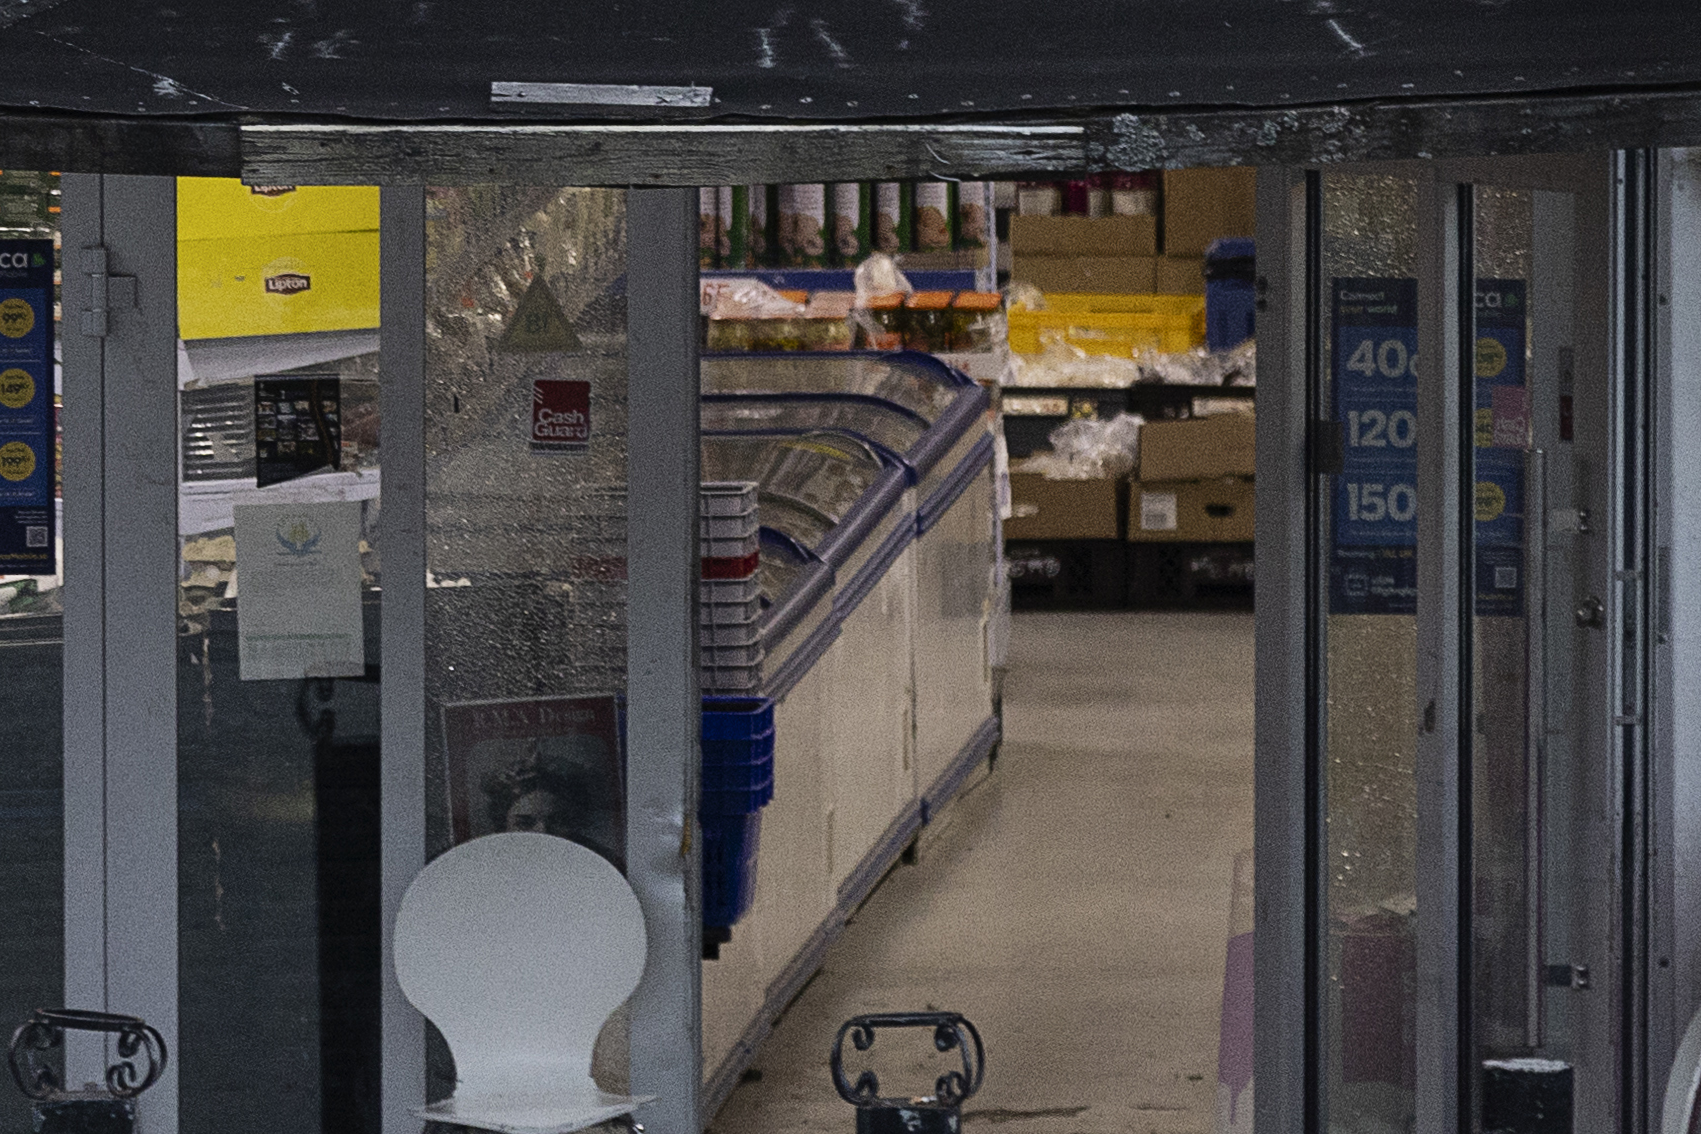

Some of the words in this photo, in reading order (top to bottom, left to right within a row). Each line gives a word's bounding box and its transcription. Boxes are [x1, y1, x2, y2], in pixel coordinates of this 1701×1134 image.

[268, 278, 307, 291] Lipton
[537, 407, 586, 424] Cash
[534, 421, 589, 439] Guard
